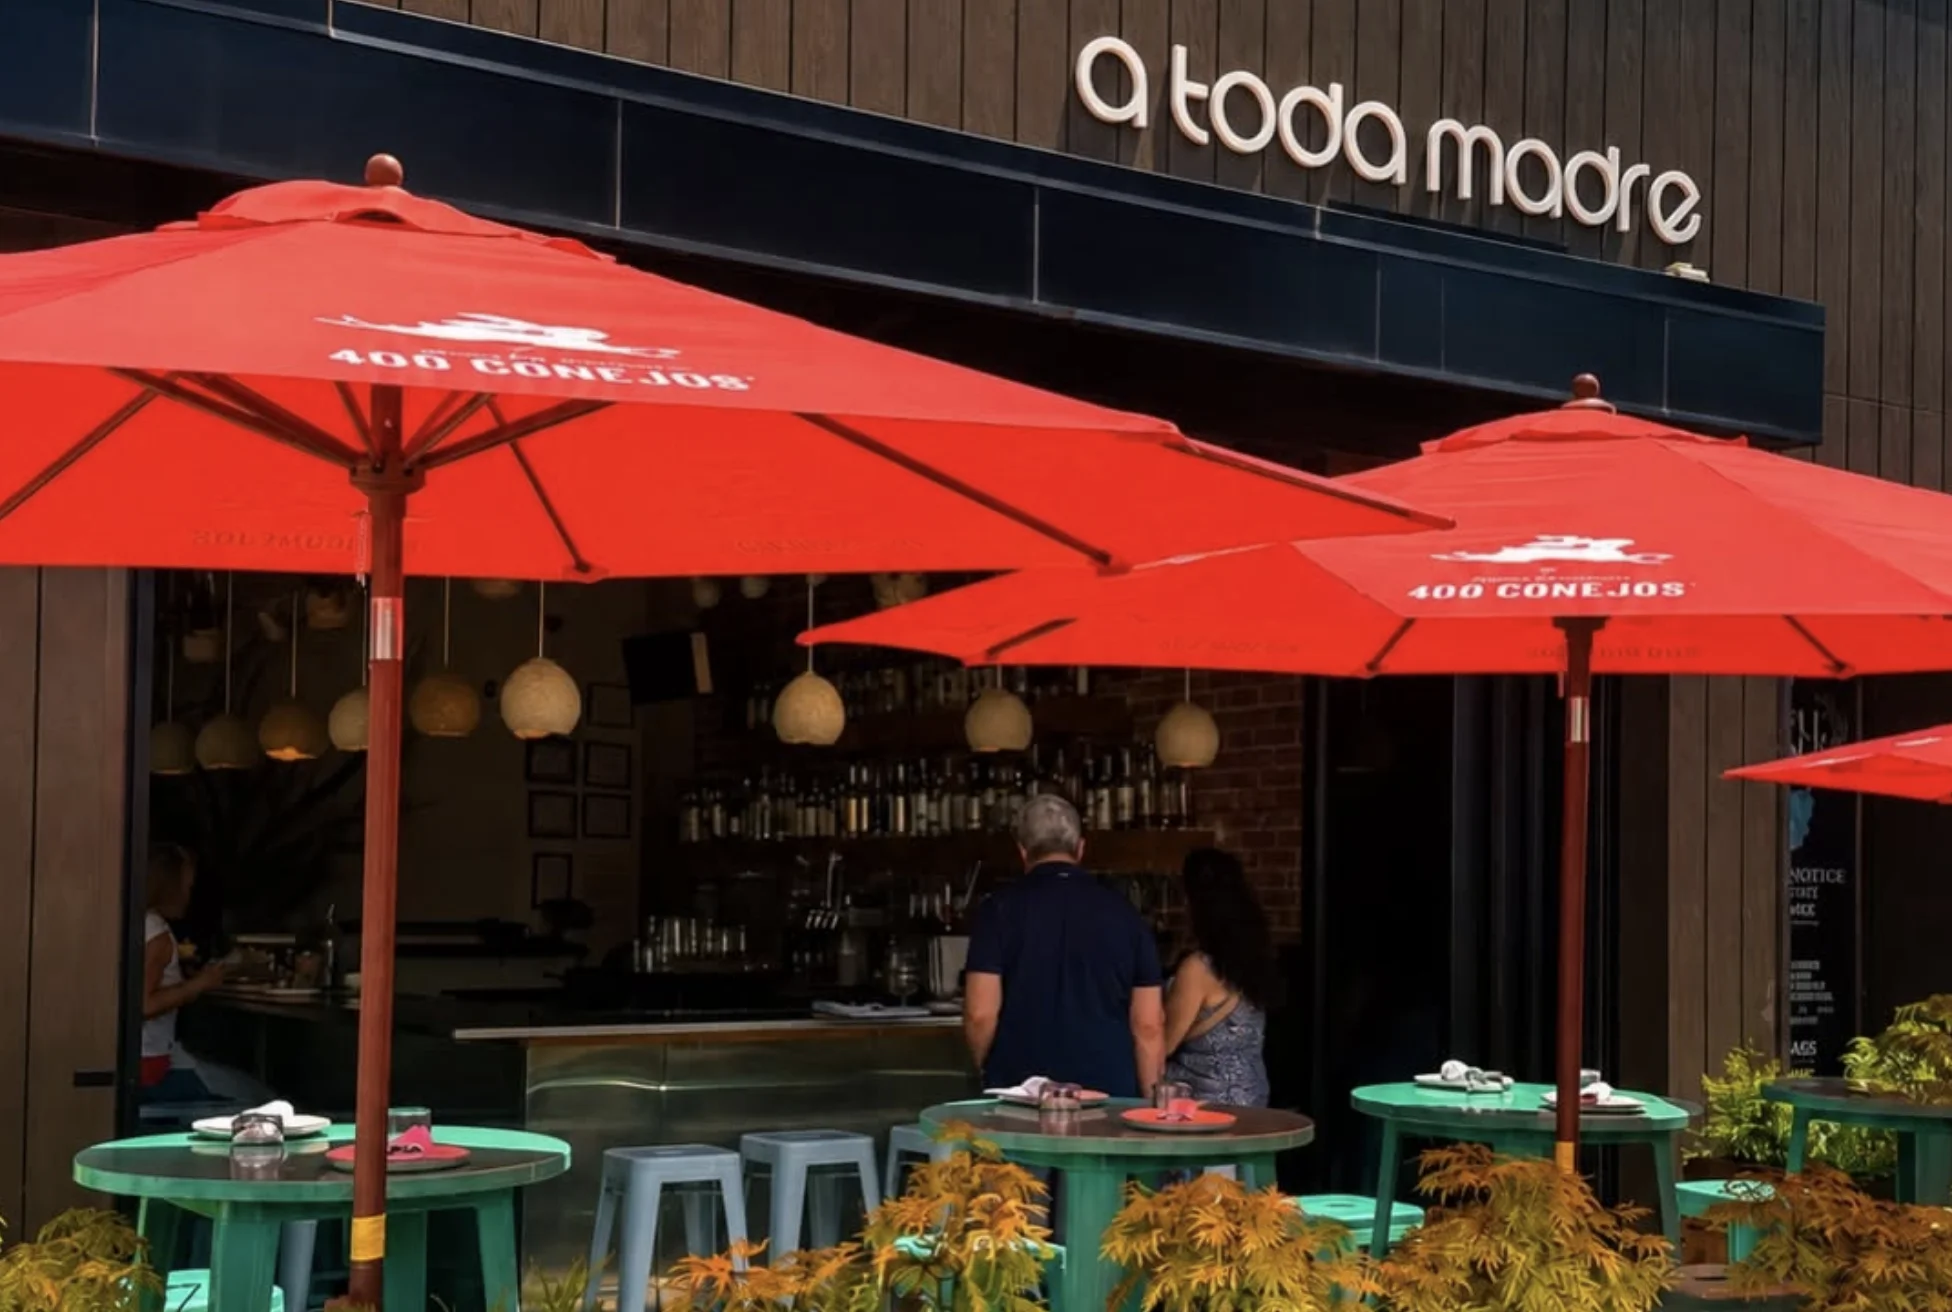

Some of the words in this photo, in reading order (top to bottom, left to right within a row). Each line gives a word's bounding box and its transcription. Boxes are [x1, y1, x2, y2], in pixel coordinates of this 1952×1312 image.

[1075, 36, 1148, 129] a
[1171, 43, 1407, 185] toda
[1426, 118, 1702, 245] madre
[329, 348, 451, 371] 400
[474, 357, 750, 391] CONEJOS
[1408, 583, 1484, 600] 400
[1496, 581, 1686, 598] CONEJOS
